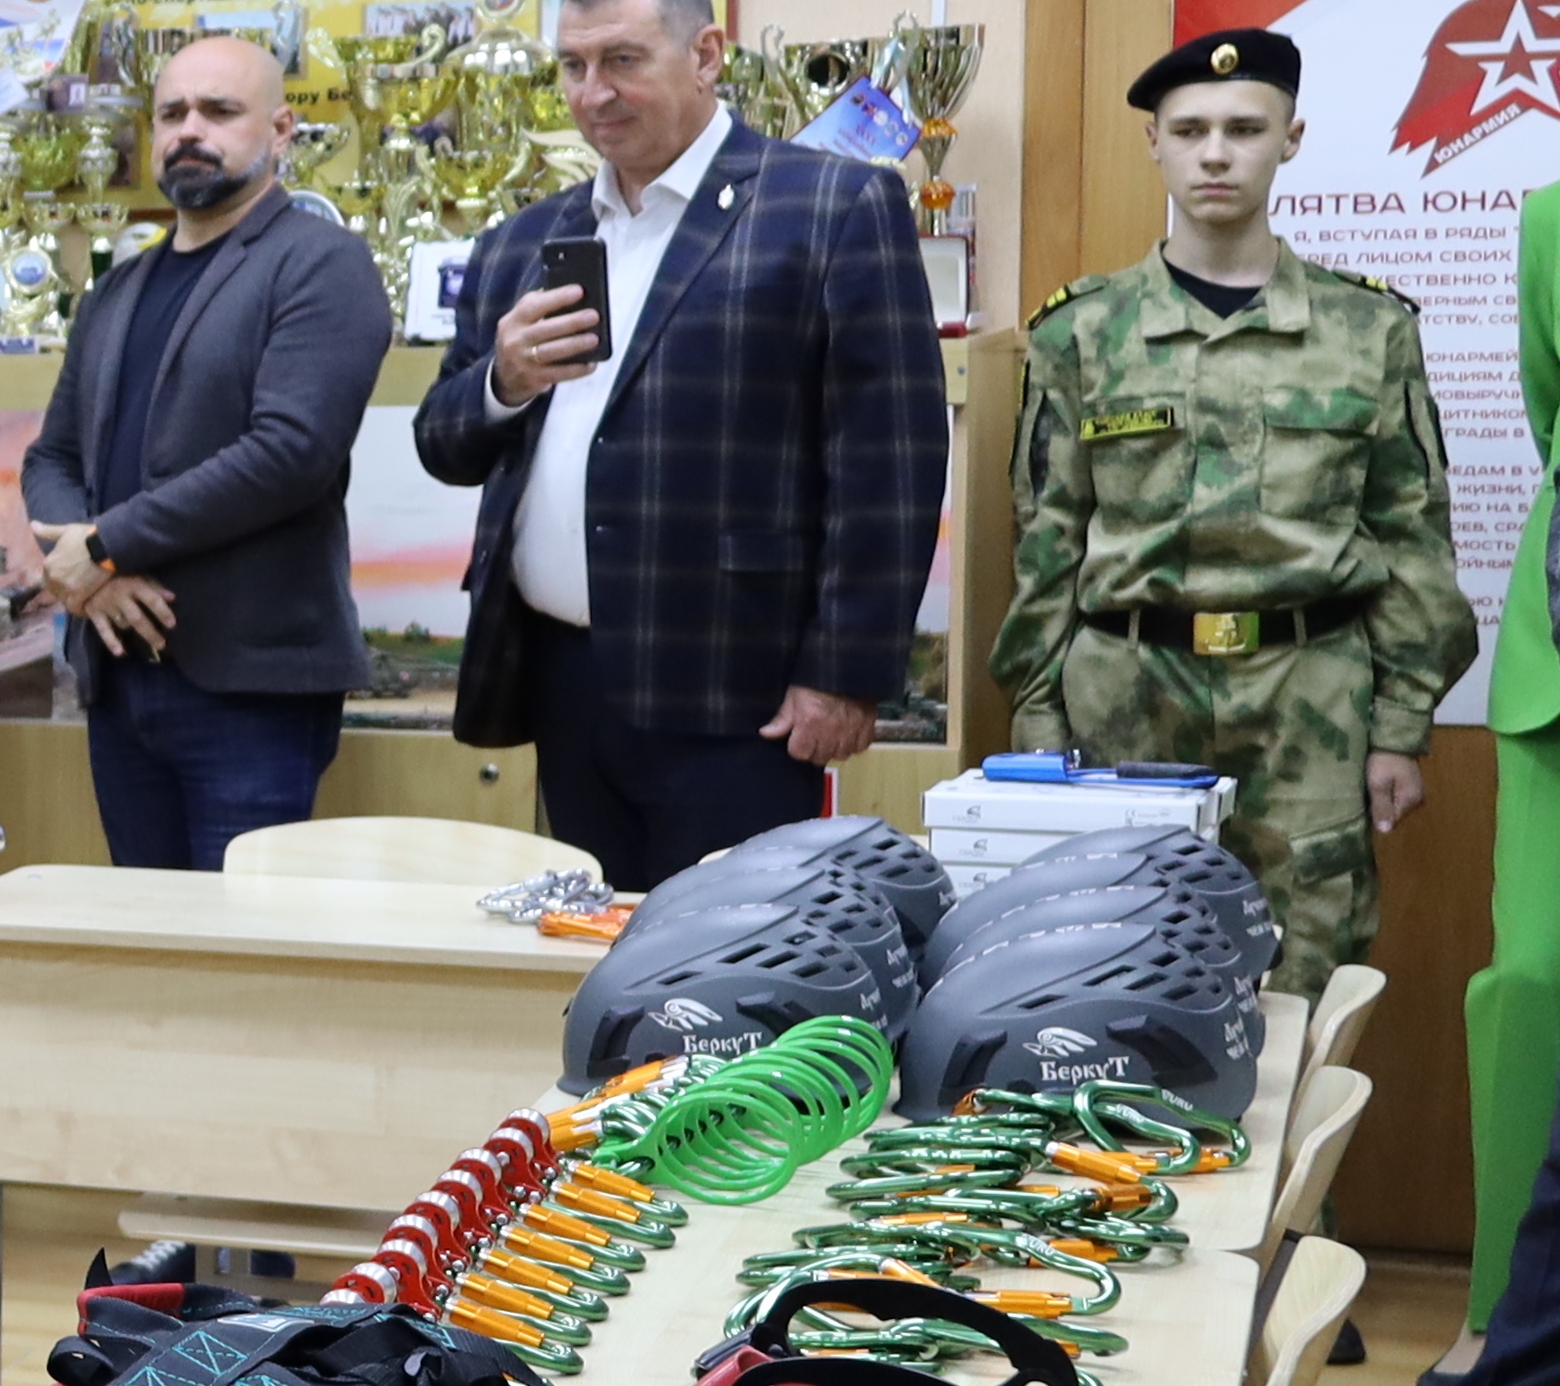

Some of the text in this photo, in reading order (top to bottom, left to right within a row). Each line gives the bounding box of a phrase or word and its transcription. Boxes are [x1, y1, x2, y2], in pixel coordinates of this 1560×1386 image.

[1434, 101, 1521, 163] ЮНАРМИЯ
[1270, 189, 1520, 216] ЛЯТВА ЮНА
[1319, 228, 1417, 242] ВСТУПАЯ
[1425, 228, 1437, 239] В
[1445, 226, 1506, 241] РЯДЫ
[1357, 251, 1432, 265] ЛИЦОМ
[1440, 249, 1511, 263] СВОИХ
[1382, 273, 1496, 287] ЕСТВЕННО
[1419, 314, 1483, 326] ТСТВУ,
[1426, 349, 1518, 362] ЮНАРМЕЙ
[1427, 371, 1502, 383] ДИЦИЯМ
[1444, 427, 1524, 439] ГРАДЫ В
[1511, 466, 1522, 476] В
[1486, 502, 1511, 512] НА
